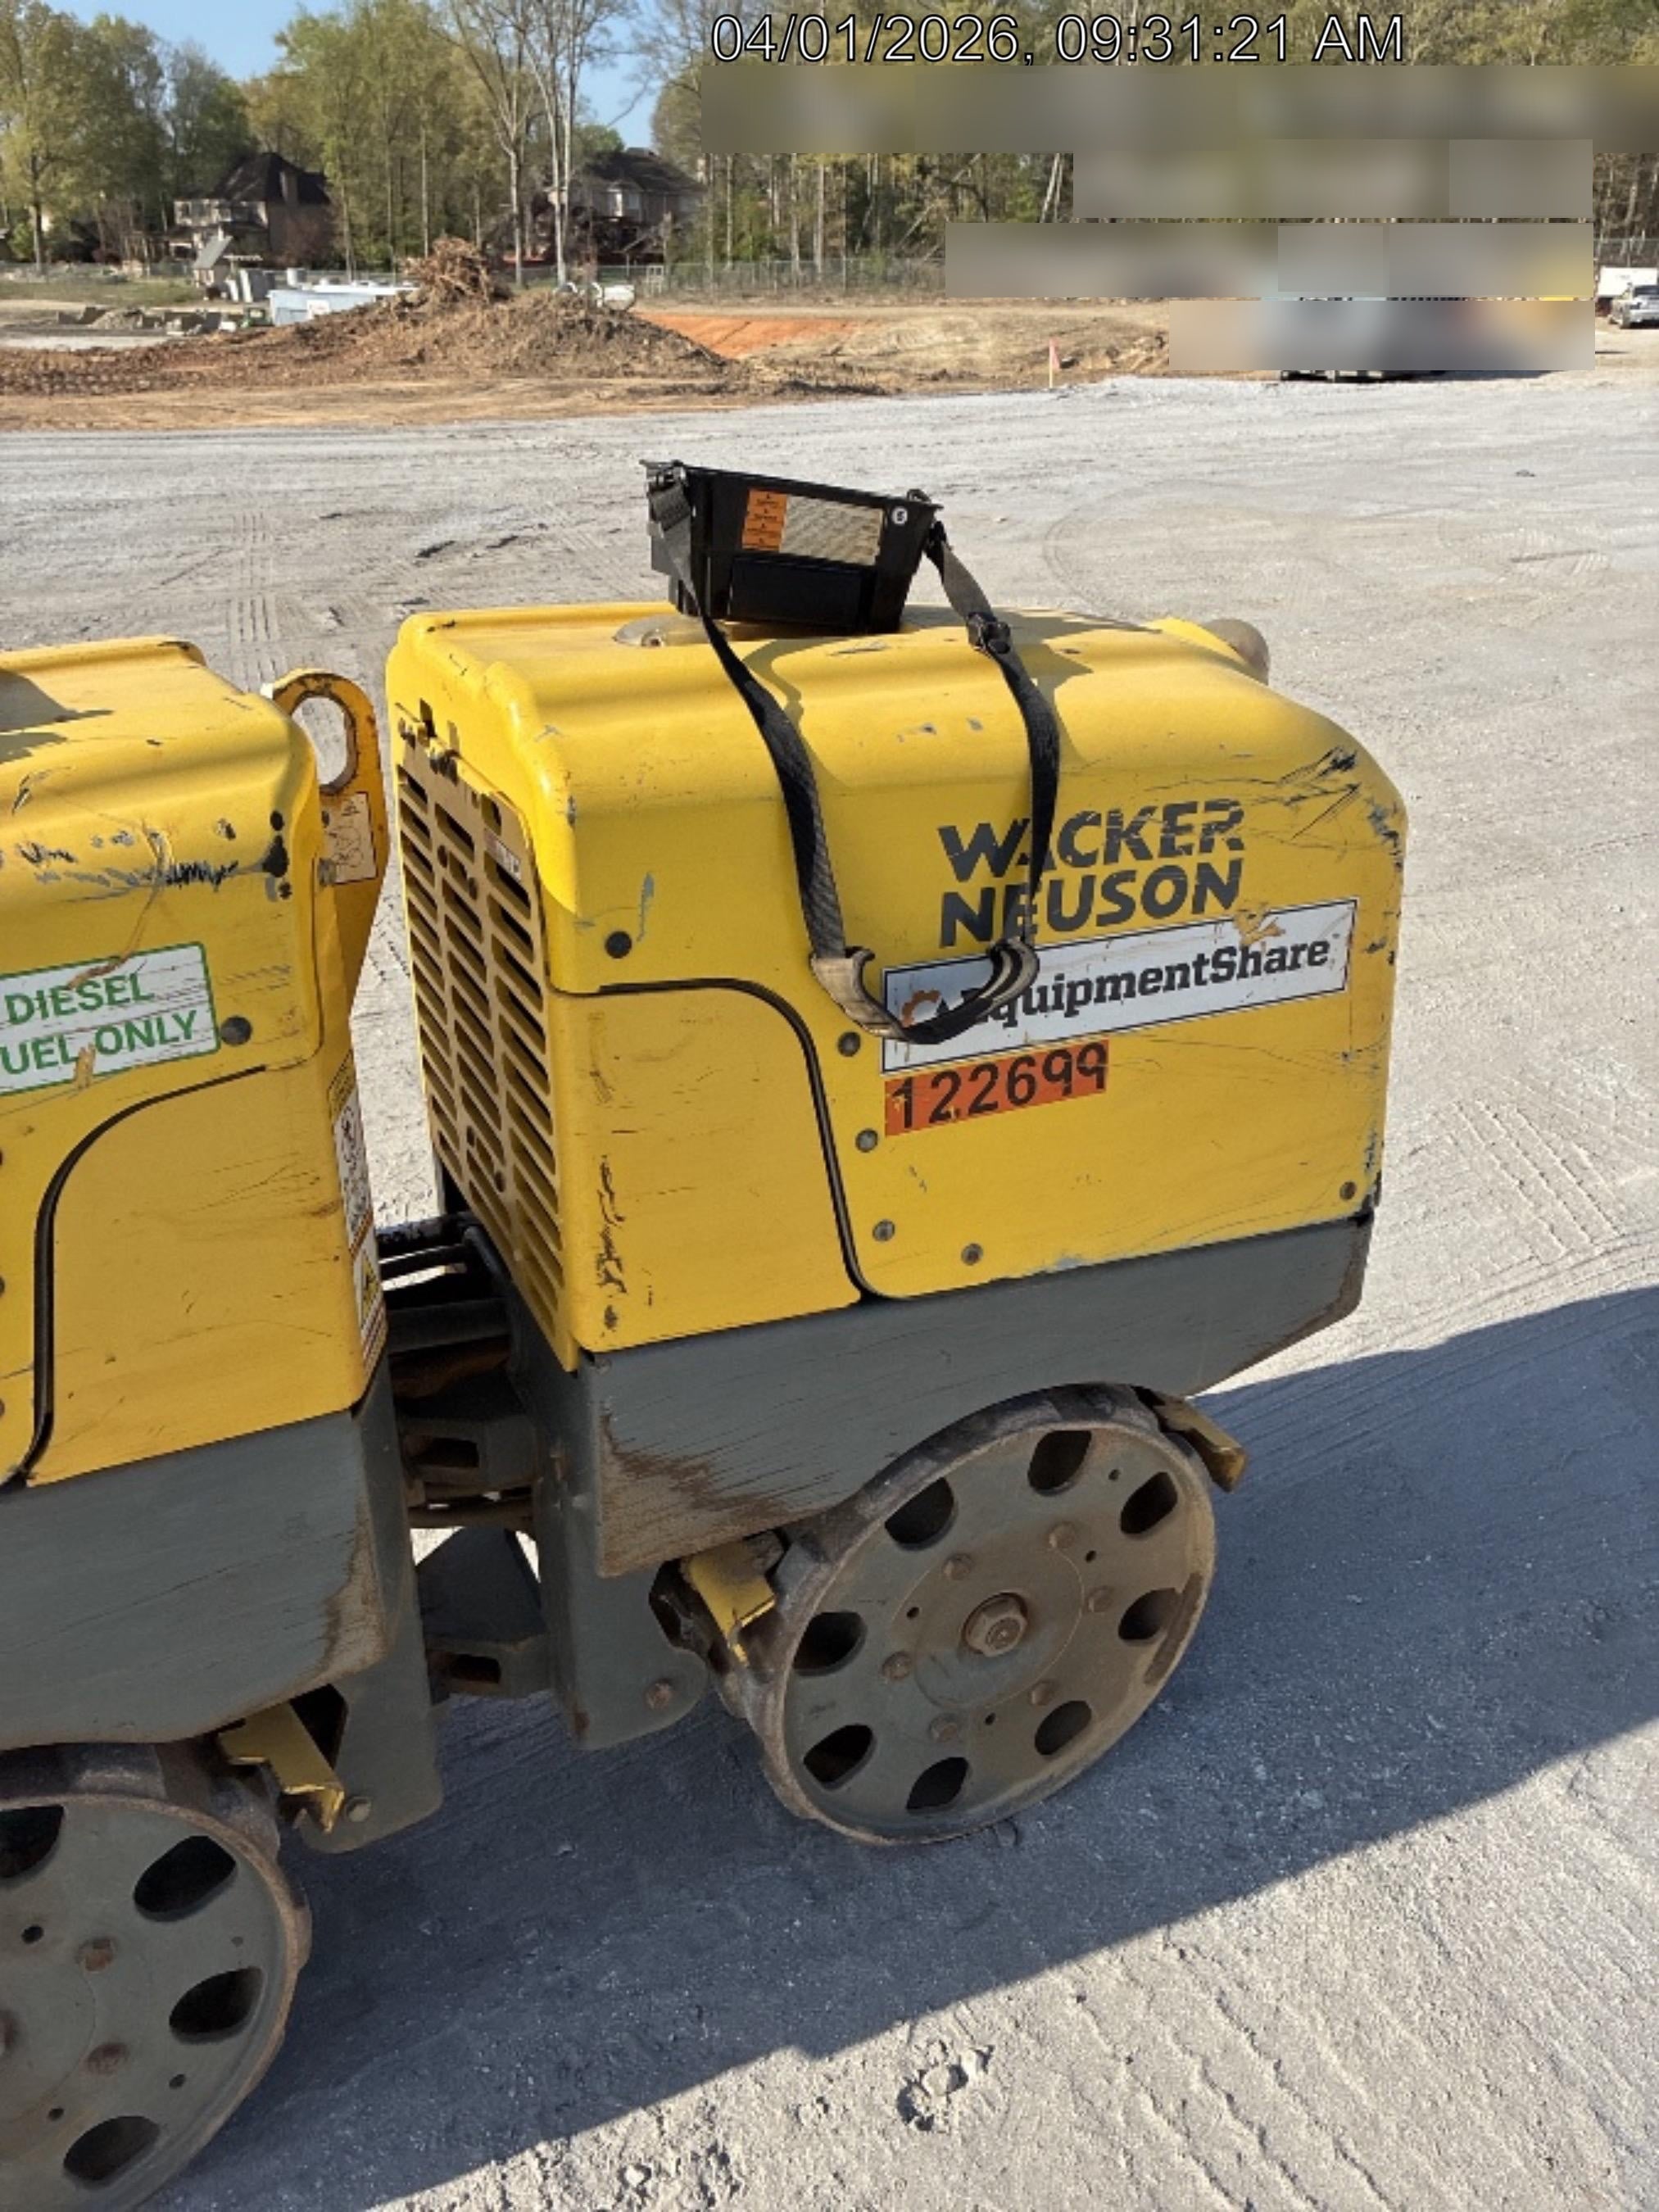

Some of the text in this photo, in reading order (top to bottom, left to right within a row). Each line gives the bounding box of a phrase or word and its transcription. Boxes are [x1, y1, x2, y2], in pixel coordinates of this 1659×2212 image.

[938, 799, 1245, 882] WCKER
[940, 859, 1242, 949] NEUSON
[4, 972, 155, 1025] DIESEL
[960, 938, 1330, 1028] quipmentShare
[0, 1009, 197, 1075] UEL ONLY
[892, 1042, 1107, 1129] 122699
